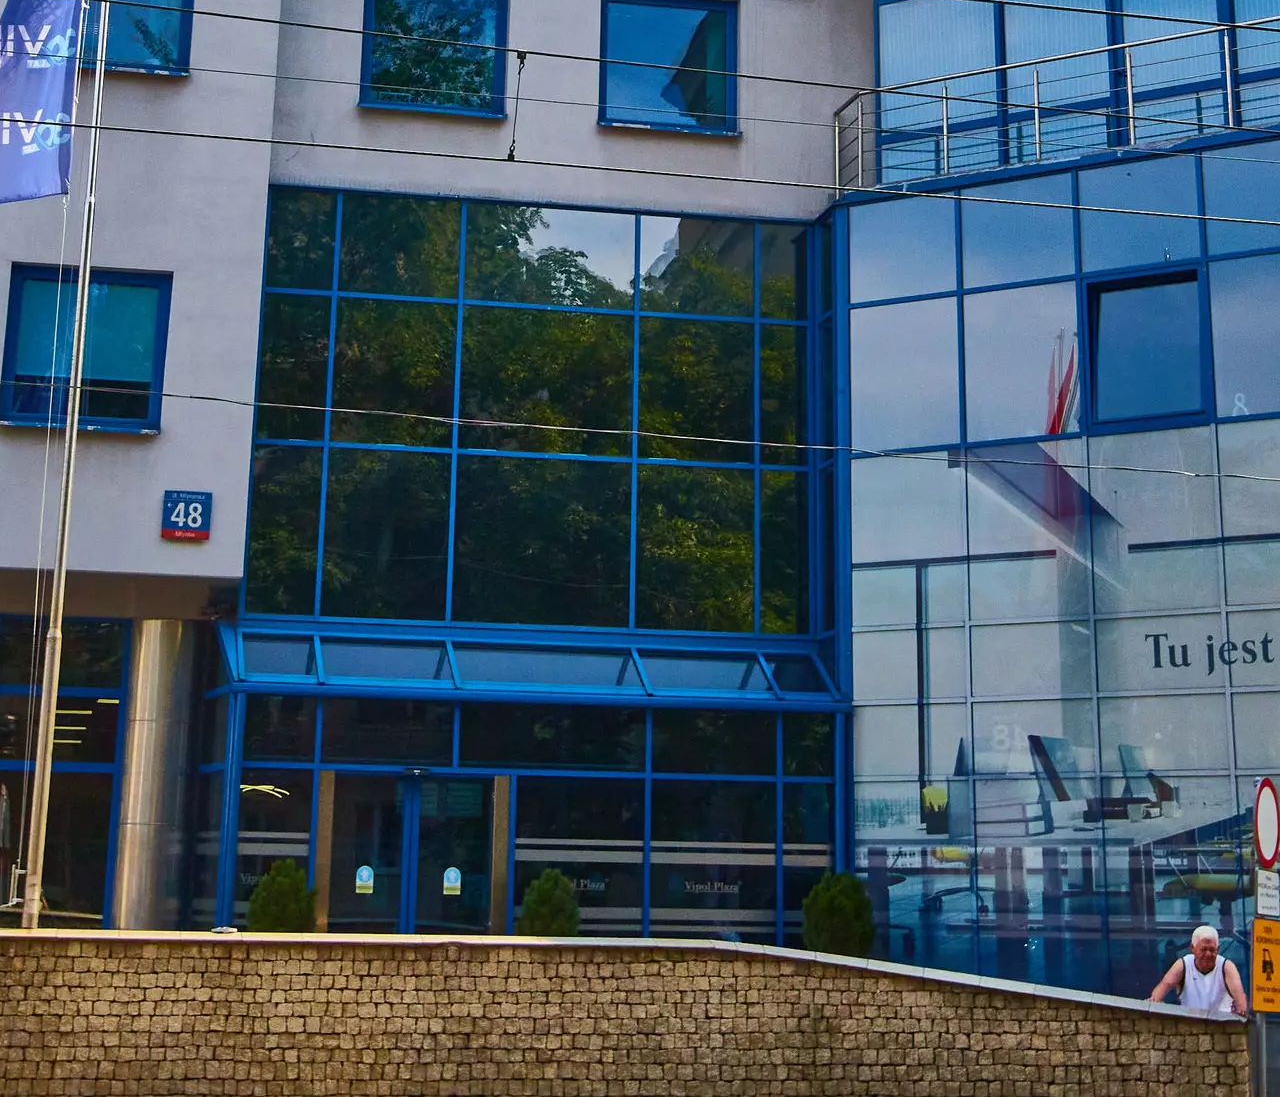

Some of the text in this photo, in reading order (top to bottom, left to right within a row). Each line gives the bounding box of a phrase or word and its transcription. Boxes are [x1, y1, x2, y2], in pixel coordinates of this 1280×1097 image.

[171, 502, 203, 528] 48
[1145, 633, 1192, 669] Tu
[1206, 631, 1274, 676] jest
[685, 880, 711, 893] Vipol
